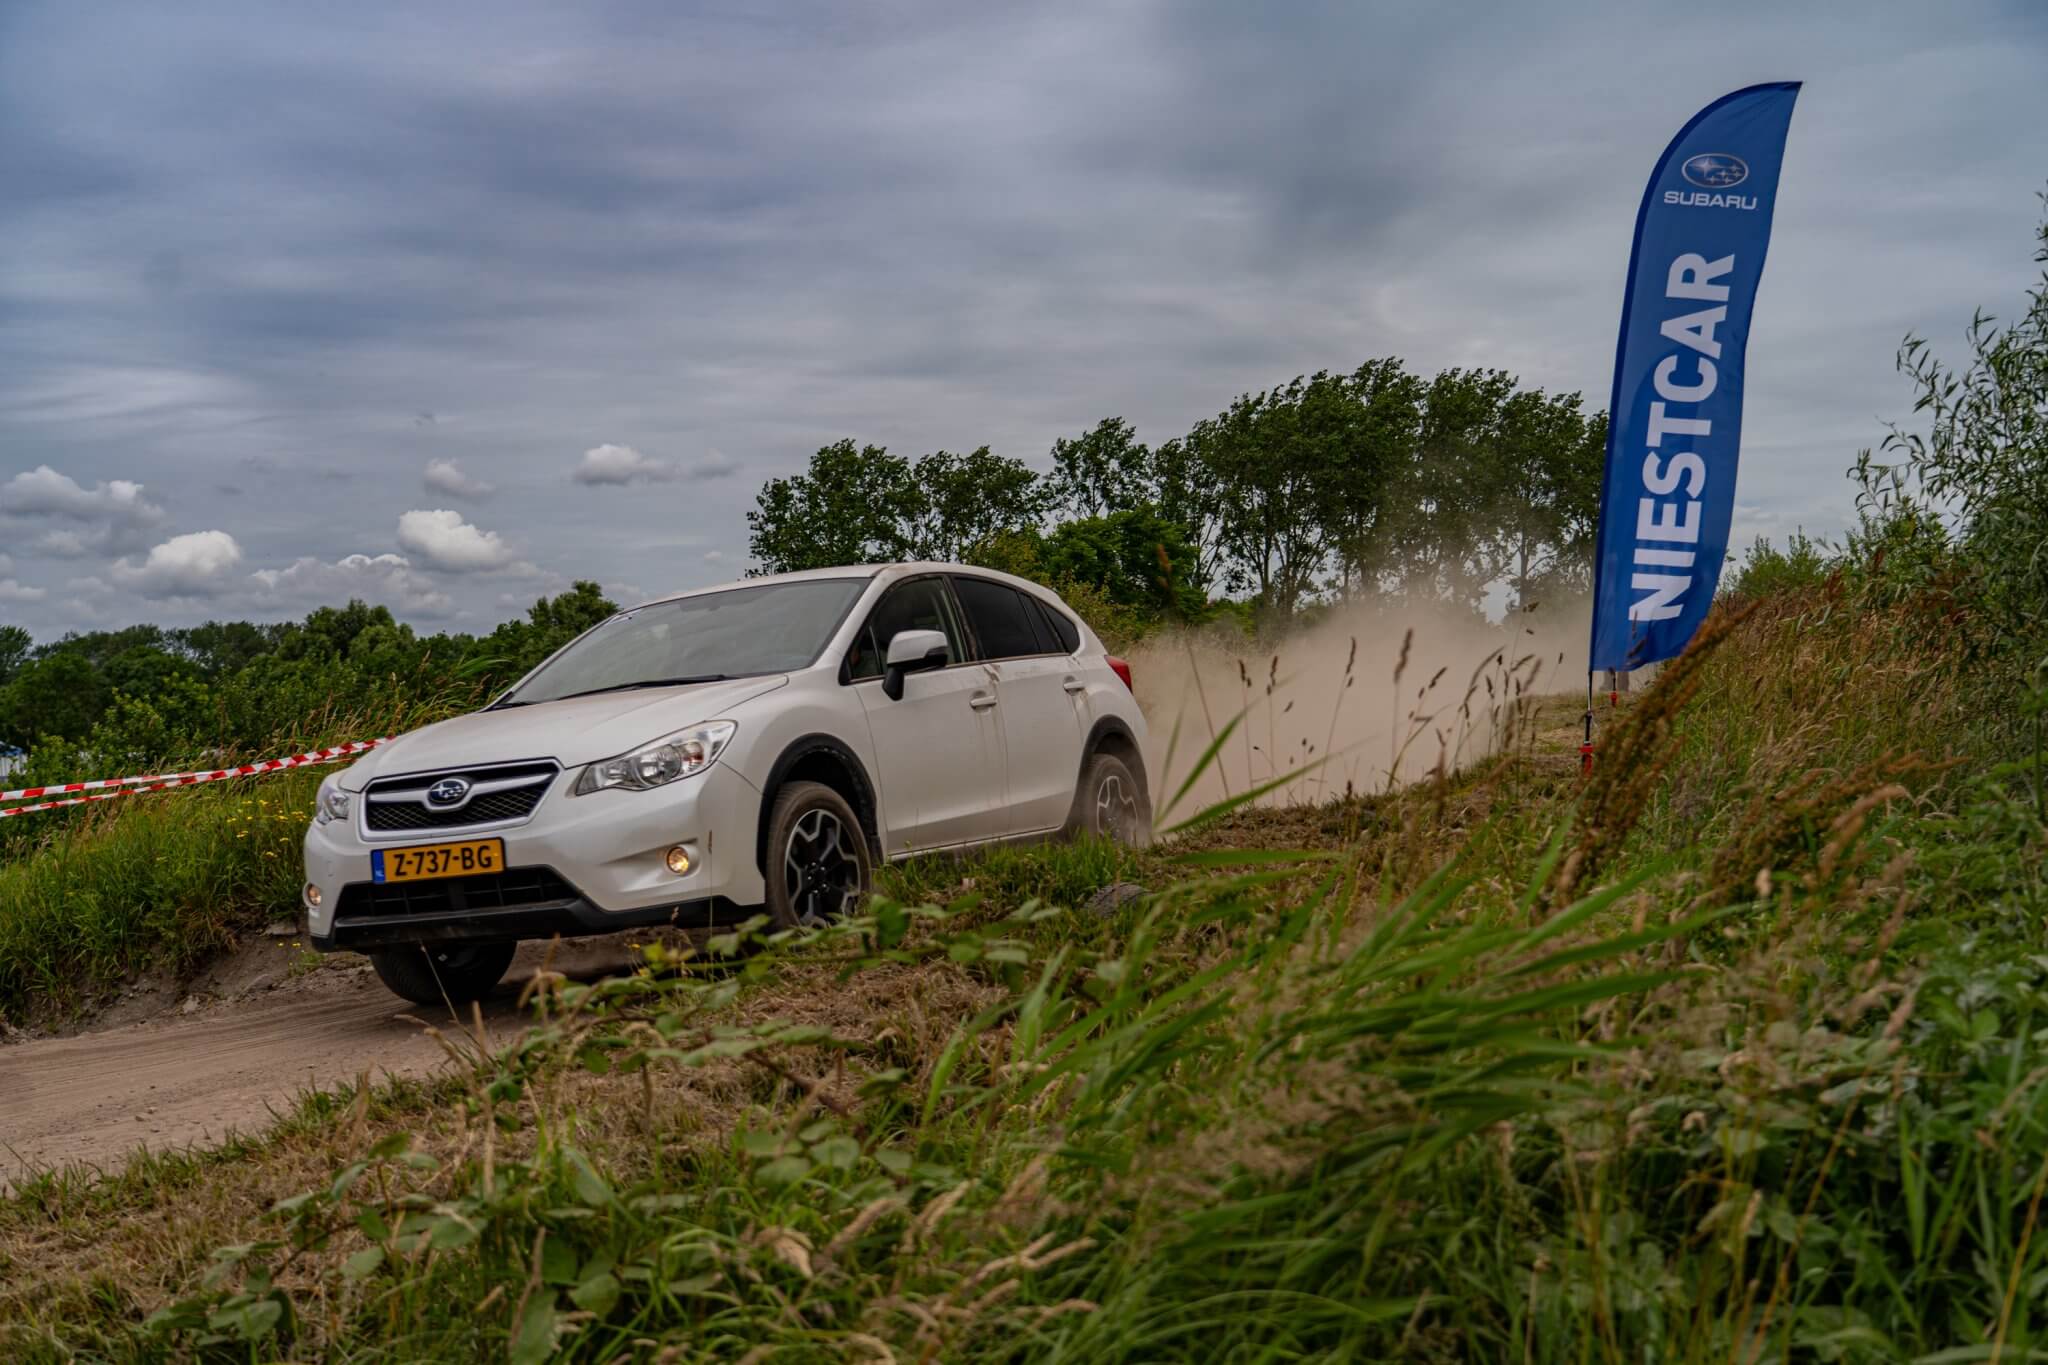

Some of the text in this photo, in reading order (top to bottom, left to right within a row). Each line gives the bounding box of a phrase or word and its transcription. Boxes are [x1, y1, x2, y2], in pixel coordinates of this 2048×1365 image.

[1663, 191, 1757, 210] SUBARU
[1628, 252, 1736, 621] NIESTCAR
[394, 845, 492, 877] Z-737-BG
